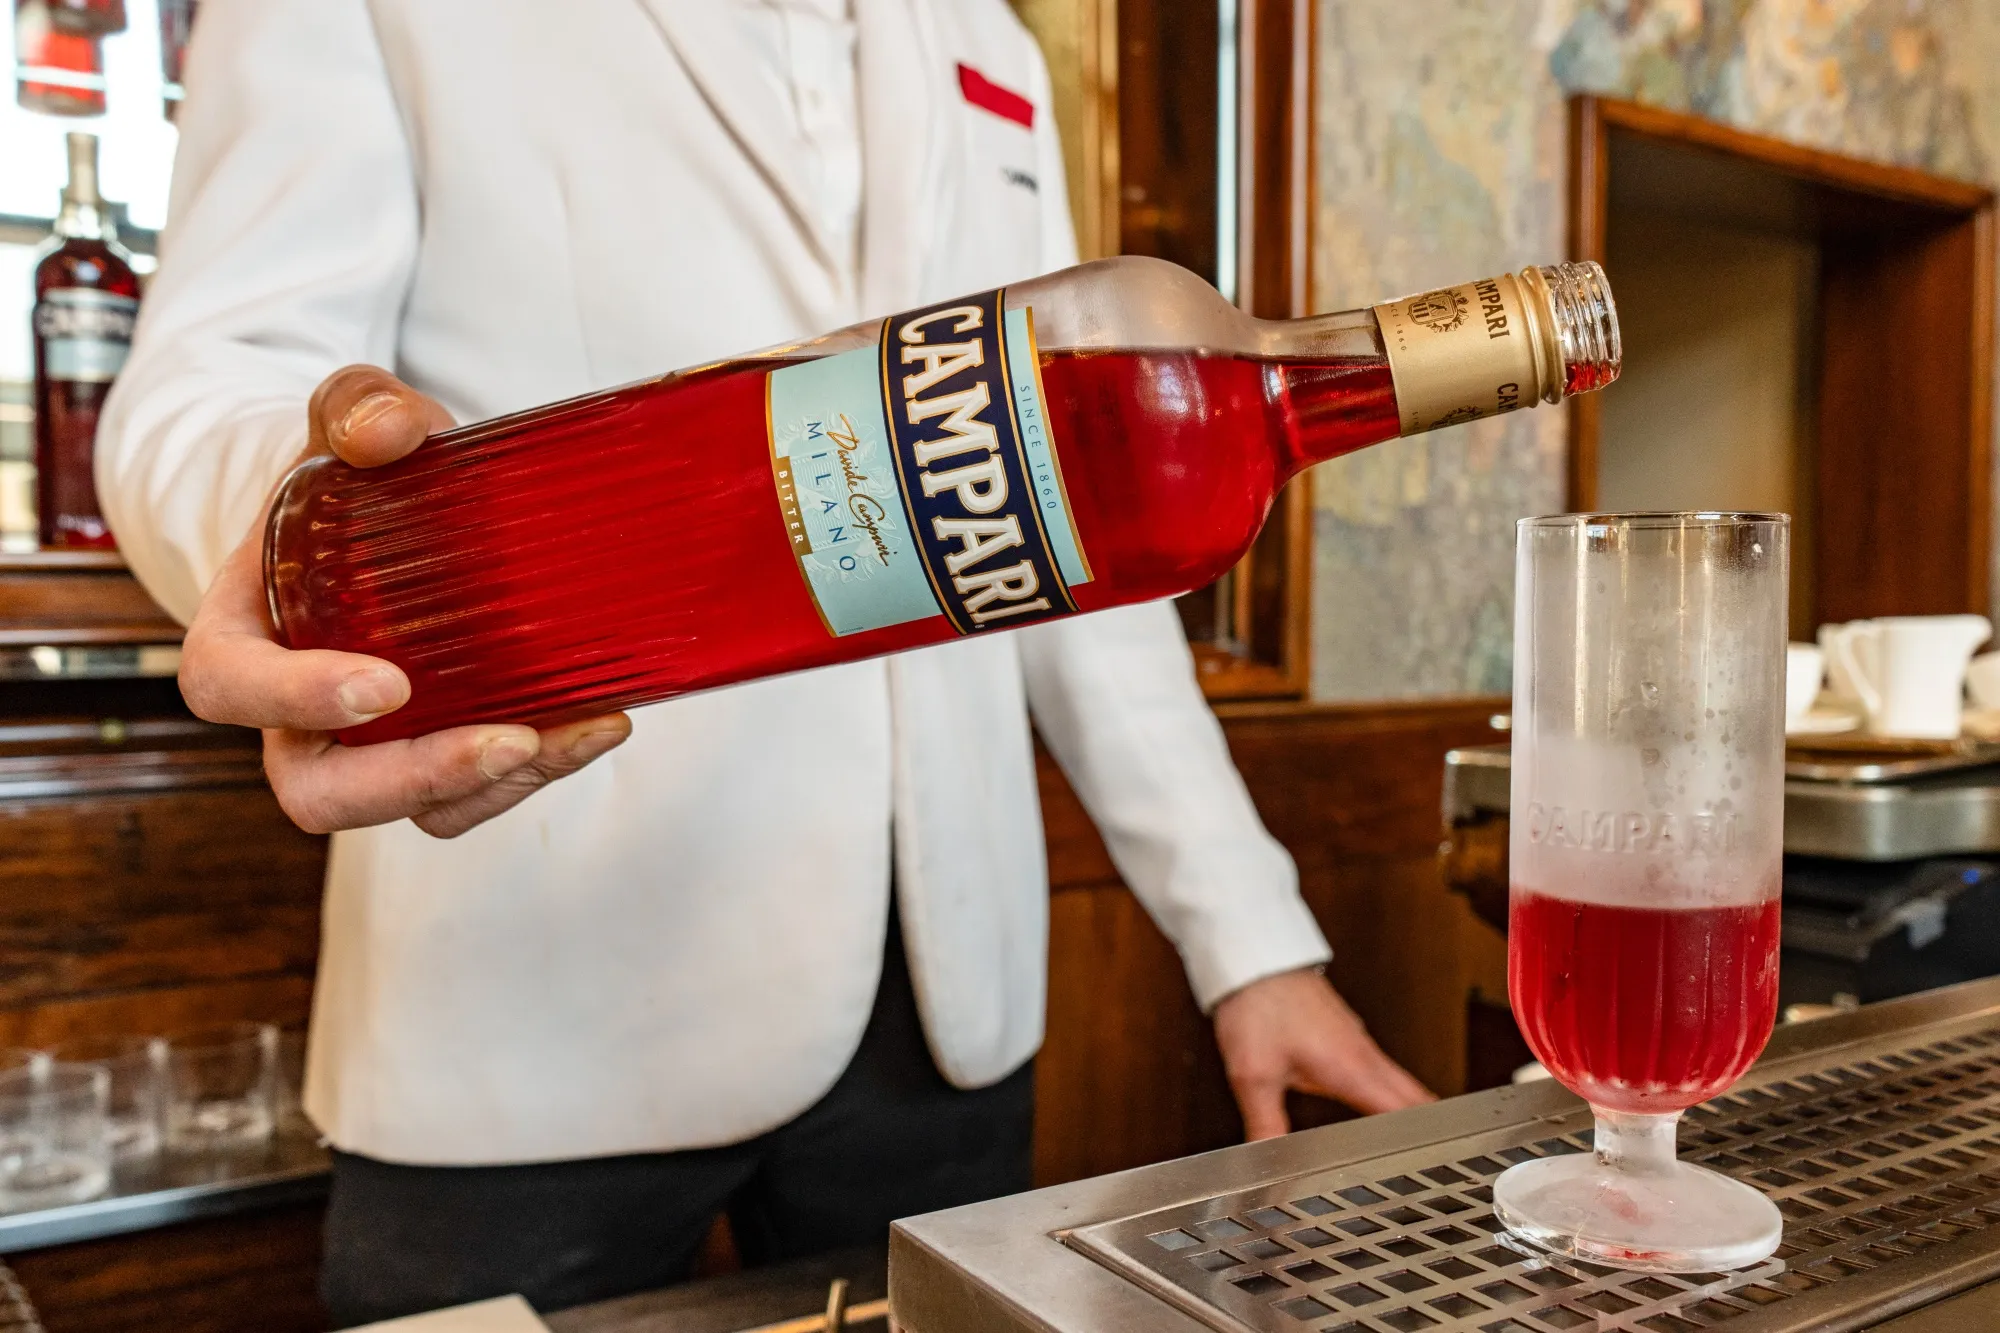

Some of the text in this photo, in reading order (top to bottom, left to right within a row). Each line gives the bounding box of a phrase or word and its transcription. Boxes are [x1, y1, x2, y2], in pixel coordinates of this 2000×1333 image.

[1472, 278, 1510, 340] AMPARI
[898, 305, 1053, 625] CAMPARI
[1020, 385, 1057, 509] SINCE 1860
[778, 470, 804, 544] BITTER
[806, 421, 857, 572] MILANO
[848, 493, 898, 567] Campari
[1526, 801, 1739, 855] CAMPARI
